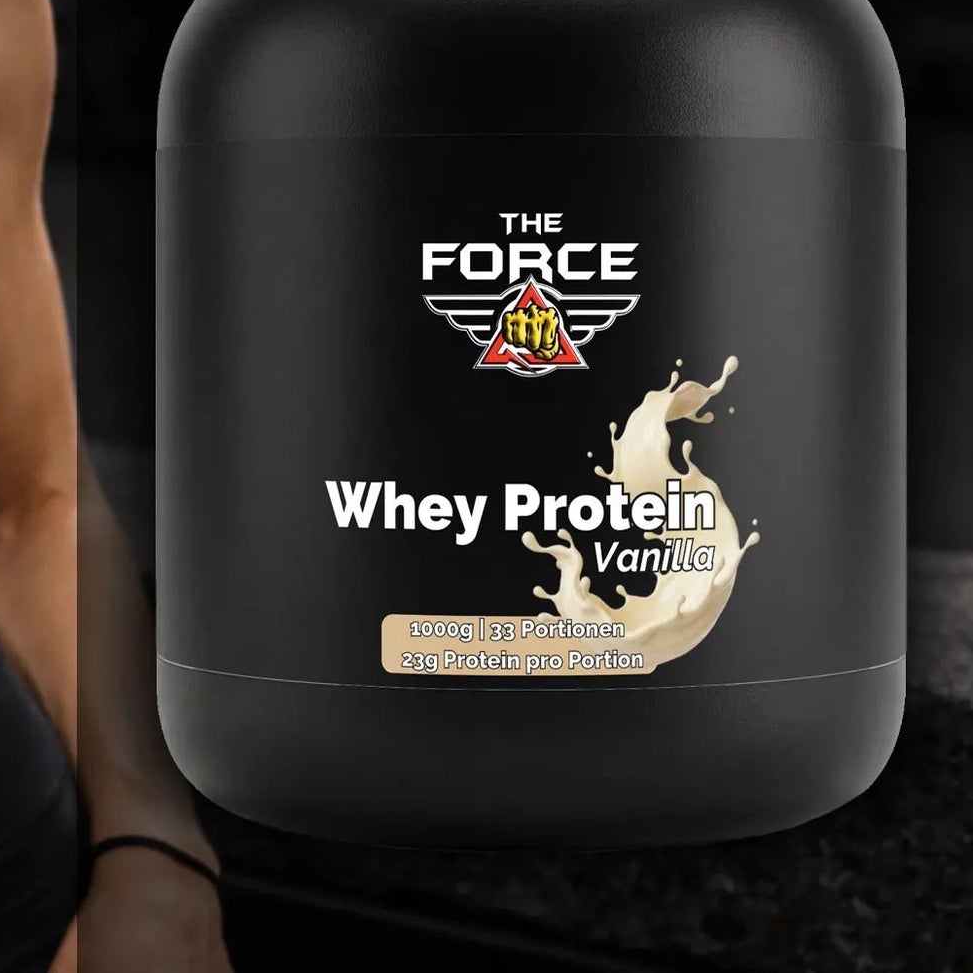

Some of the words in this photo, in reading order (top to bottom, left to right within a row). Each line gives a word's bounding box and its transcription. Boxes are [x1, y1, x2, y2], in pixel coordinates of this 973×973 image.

[498, 213, 564, 235] THE
[422, 243, 639, 284] FORCE
[325, 480, 488, 546] Whey
[504, 479, 716, 531] Protein
[593, 538, 715, 573] Vanilla
[410, 621, 473, 642] 1000g
[490, 623, 515, 641] 33
[521, 619, 625, 639] Portionen
[401, 652, 438, 672] 23g
[443, 650, 520, 669] Protein
[526, 656, 563, 674] pro
[568, 650, 643, 669] Portion
